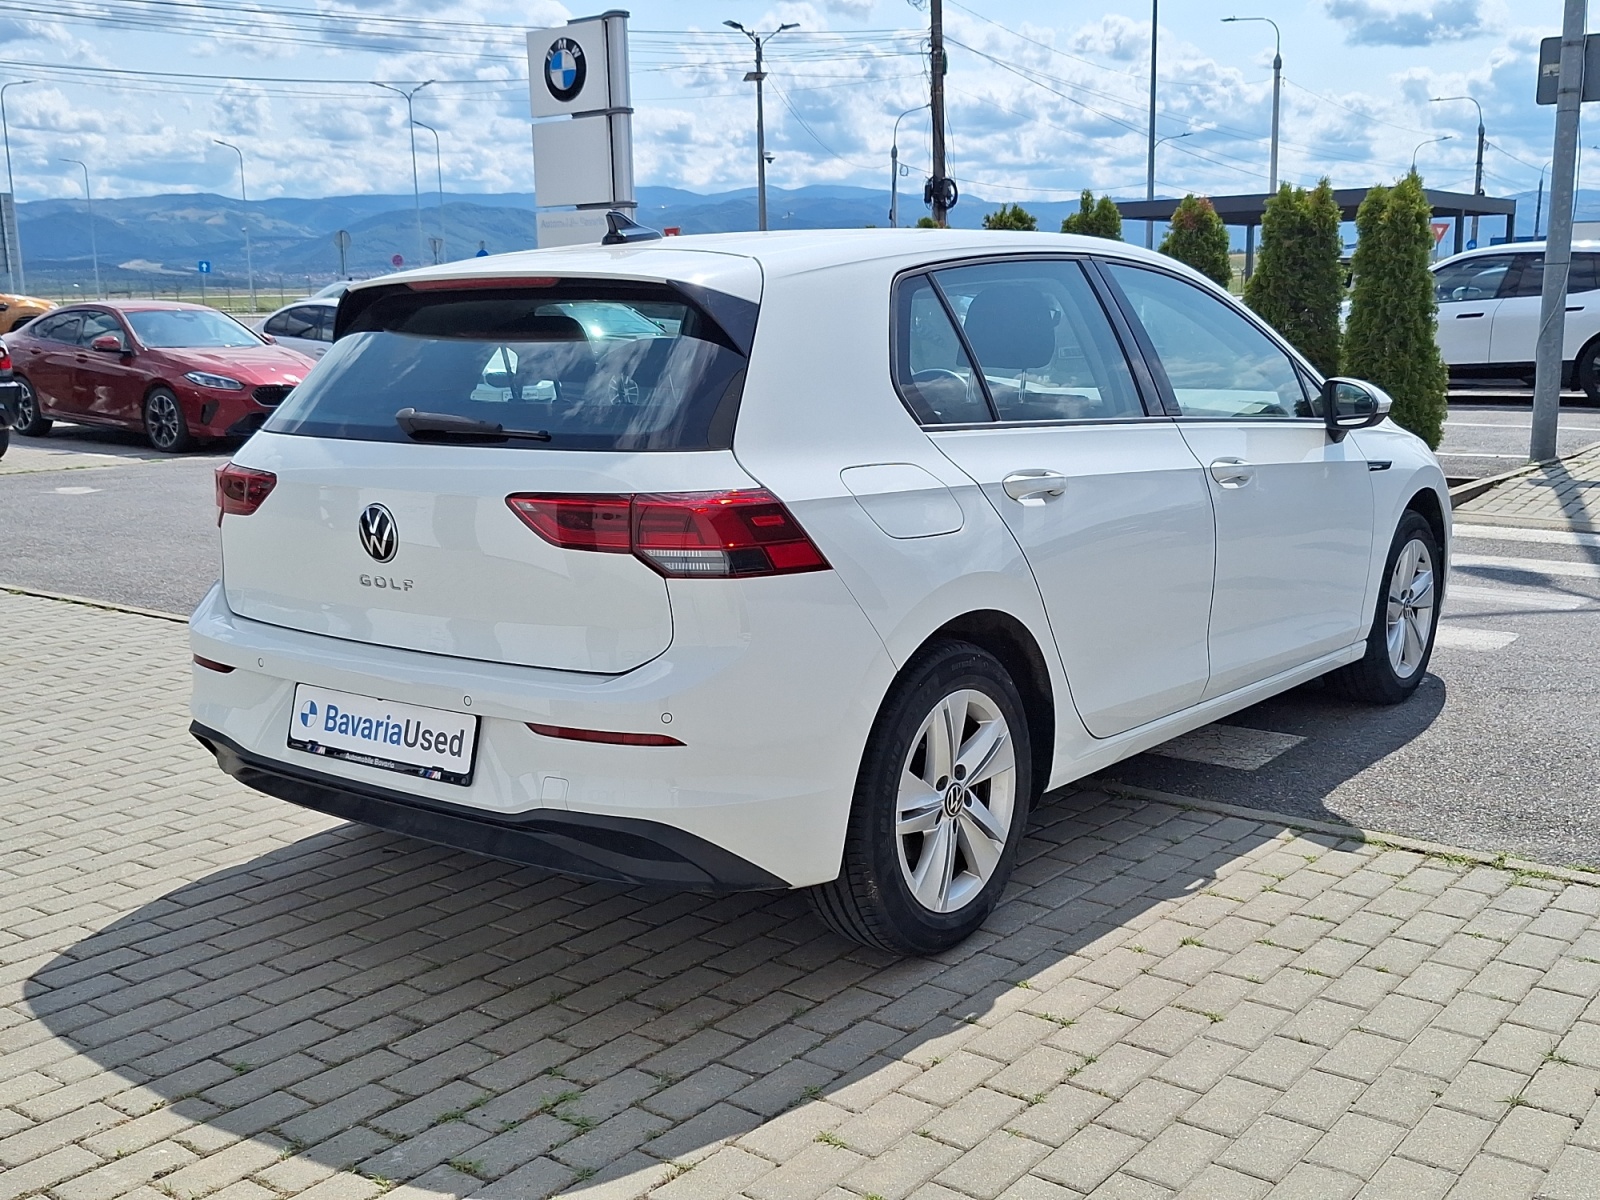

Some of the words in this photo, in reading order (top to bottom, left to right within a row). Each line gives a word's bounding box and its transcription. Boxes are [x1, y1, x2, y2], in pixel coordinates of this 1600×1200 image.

[546, 39, 582, 61] BMW
[359, 573, 414, 592] GOLF
[324, 704, 465, 757] BavariaUsed
[345, 752, 374, 765] Automobile
[374, 758, 395, 769] Bavaria
